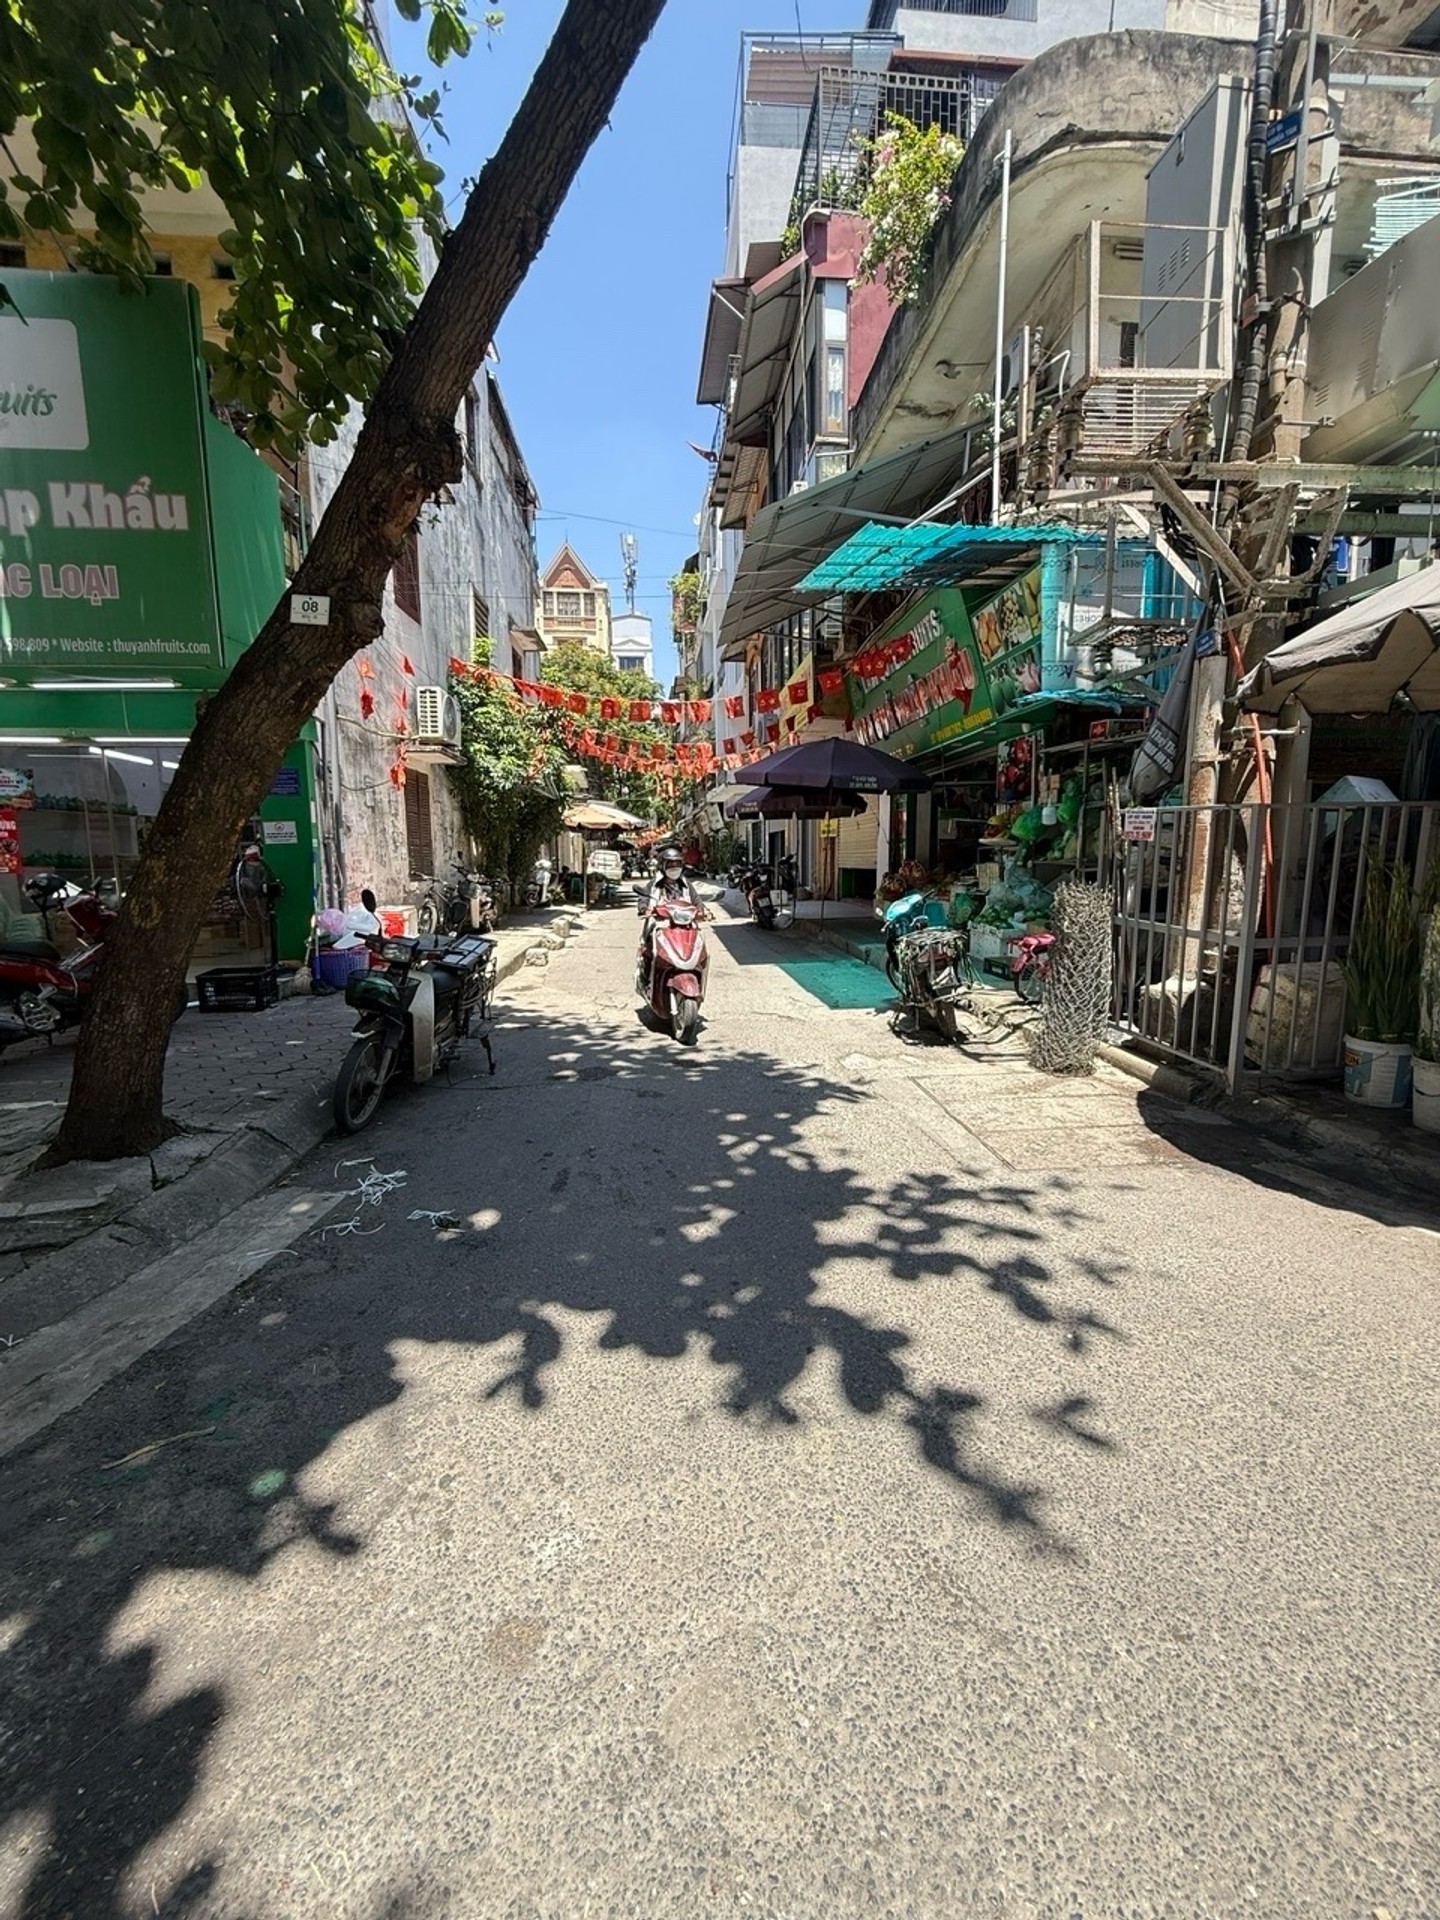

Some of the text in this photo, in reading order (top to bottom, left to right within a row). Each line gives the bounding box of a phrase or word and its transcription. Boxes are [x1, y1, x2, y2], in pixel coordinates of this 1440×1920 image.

[48, 475, 190, 531] Khẩu
[39, 563, 120, 606] LOẠI
[301, 600, 319, 613] 08
[60, 637, 104, 652] Website
[113, 637, 211, 655] thuyanhfruits.com
